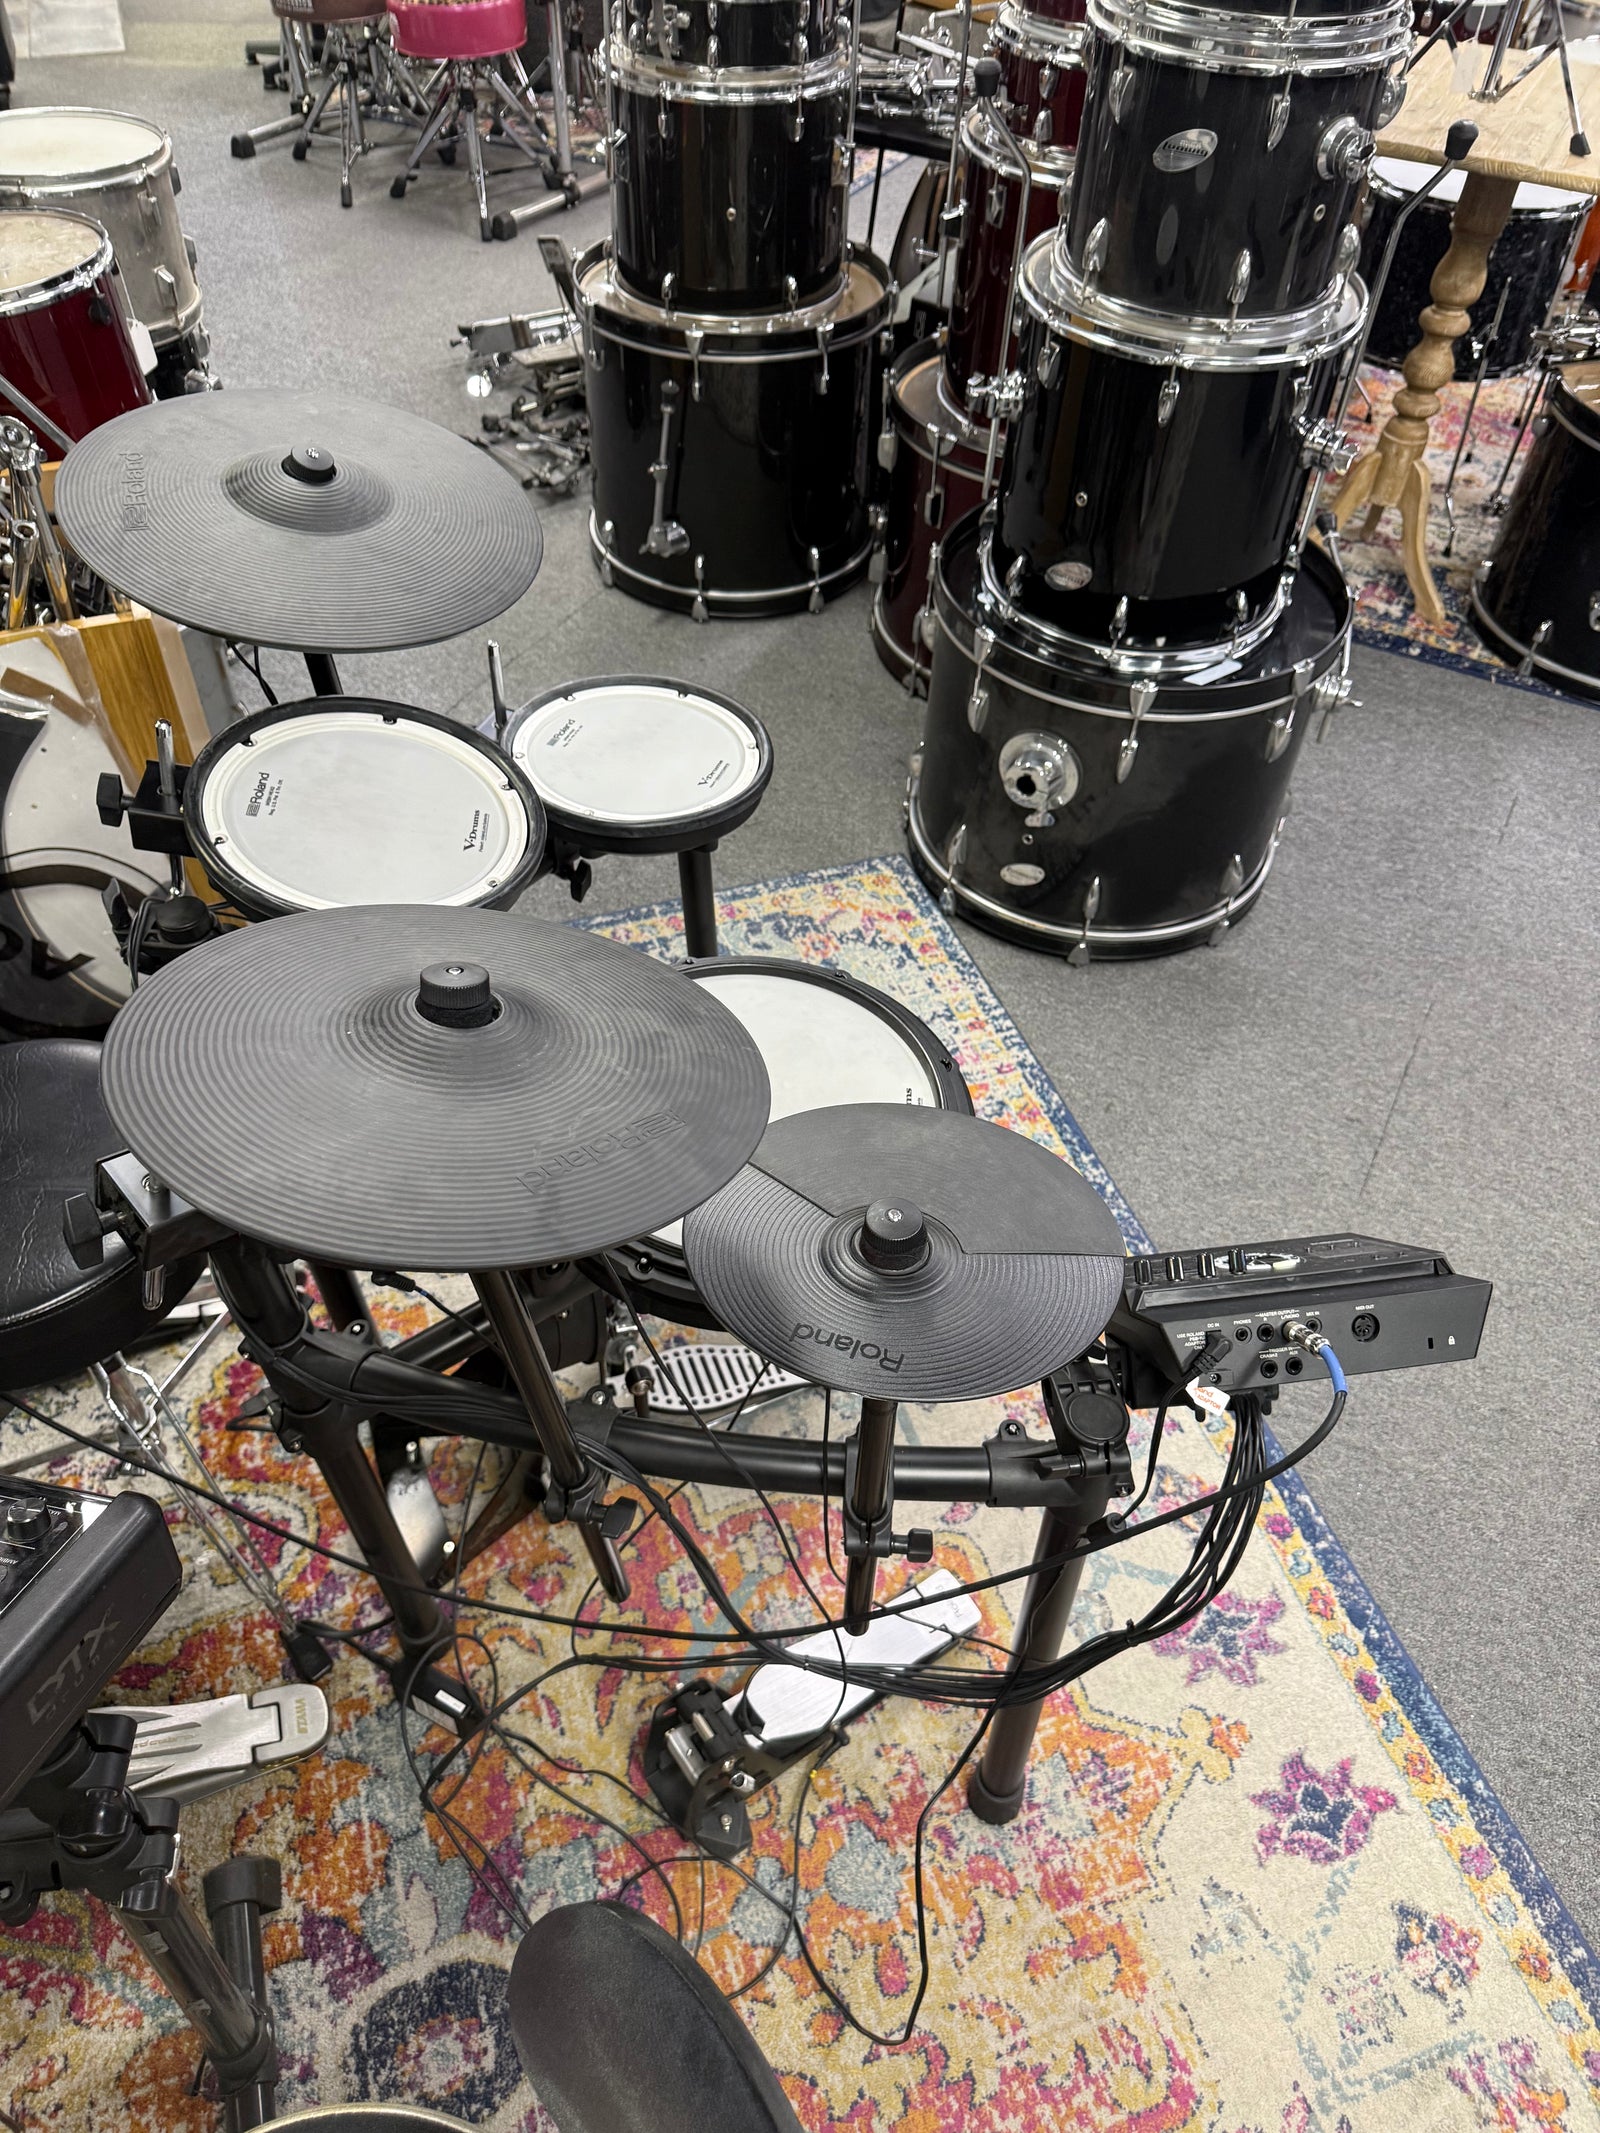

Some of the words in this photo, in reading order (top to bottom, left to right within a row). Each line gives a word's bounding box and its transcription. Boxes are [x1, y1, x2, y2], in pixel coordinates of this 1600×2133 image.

[119, 452, 147, 507] Roland
[250, 771, 270, 804] Roland
[514, 1127, 648, 1195] Roland
[789, 1323, 905, 1374] Roland
